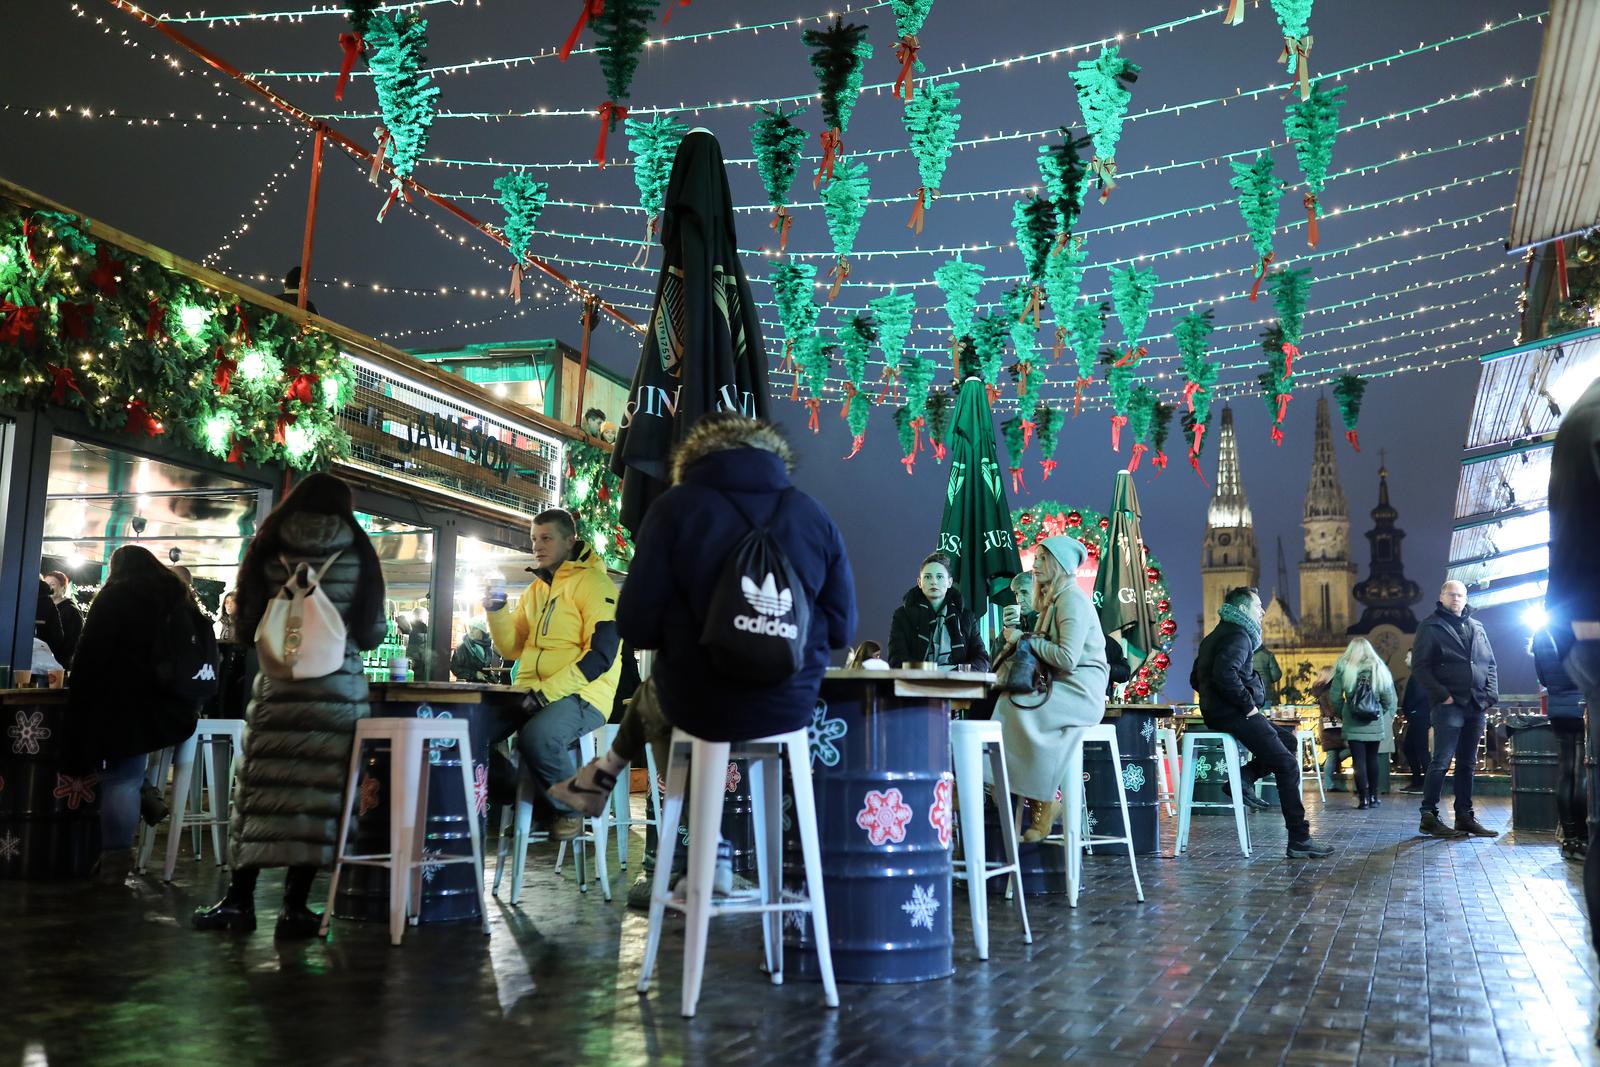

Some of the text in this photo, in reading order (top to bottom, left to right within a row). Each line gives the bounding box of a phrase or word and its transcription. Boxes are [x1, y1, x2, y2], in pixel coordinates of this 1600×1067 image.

[660, 336, 671, 360] 1759
[398, 412, 511, 484] JAMESON
[734, 614, 798, 640] adidas
